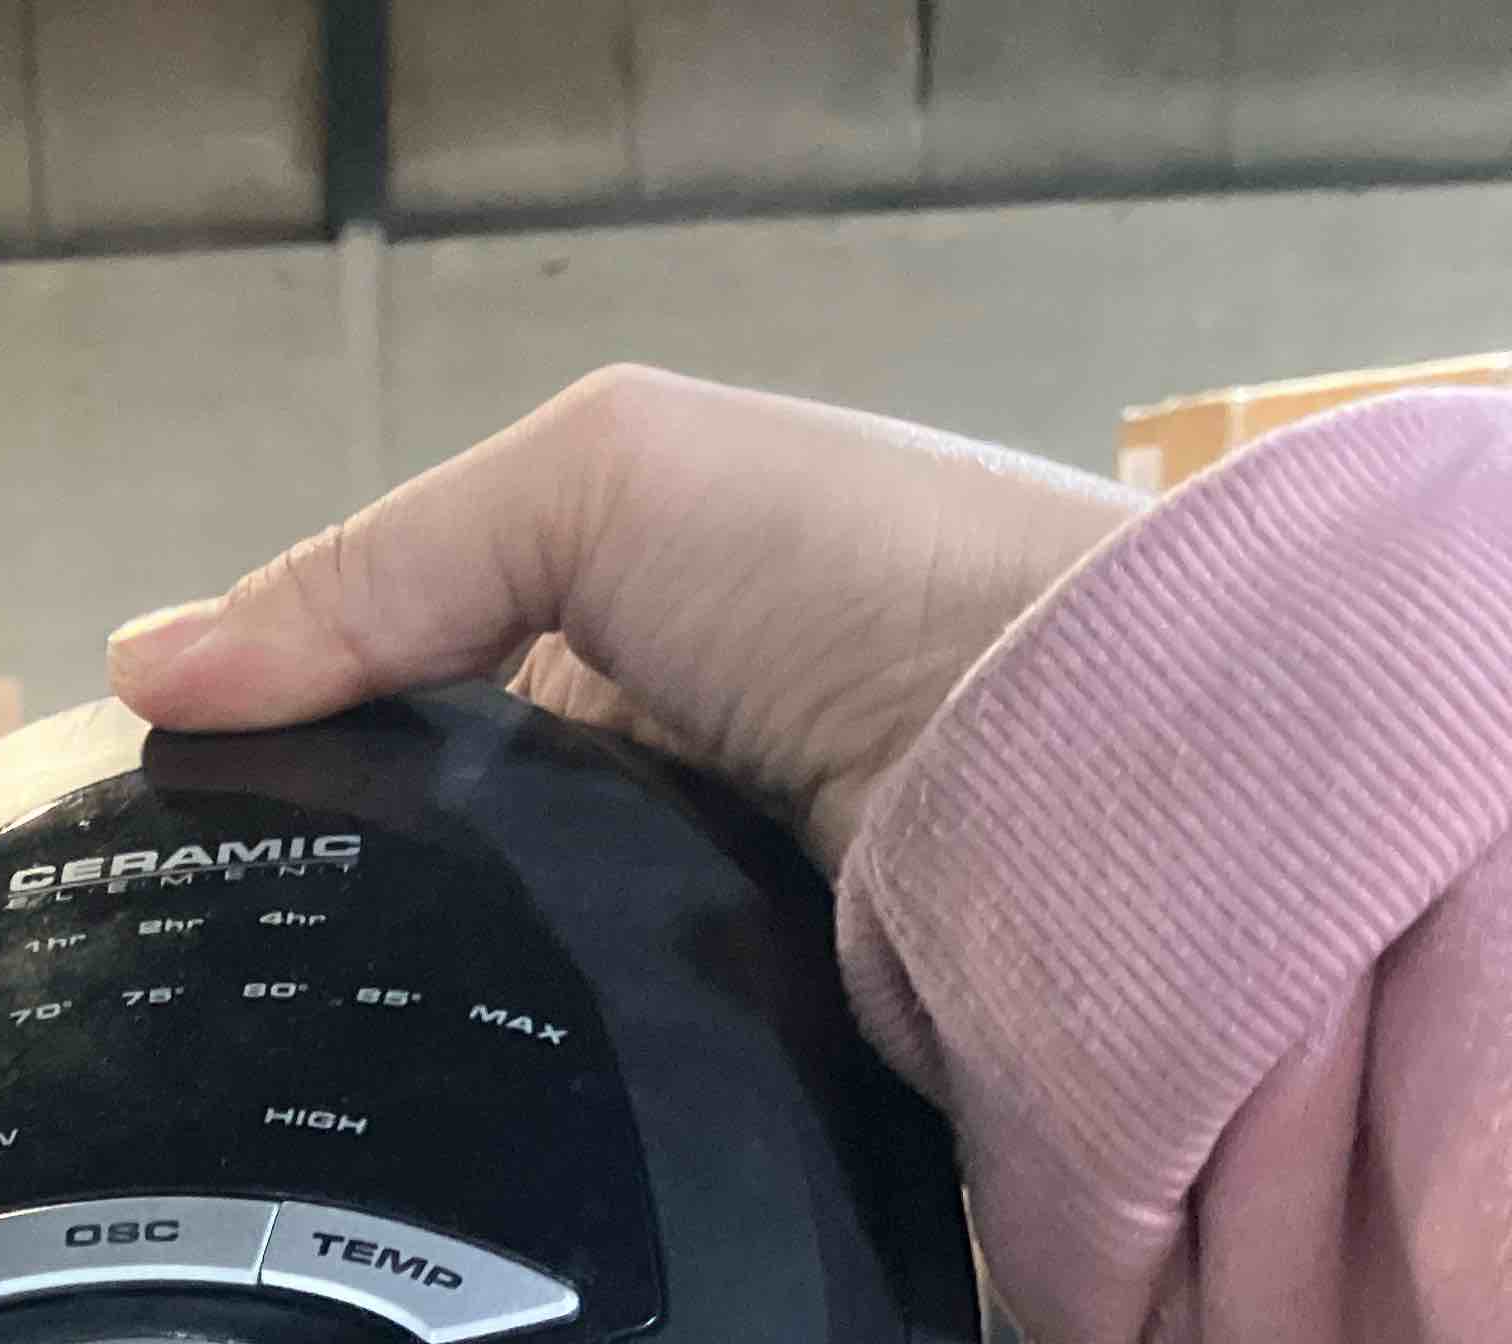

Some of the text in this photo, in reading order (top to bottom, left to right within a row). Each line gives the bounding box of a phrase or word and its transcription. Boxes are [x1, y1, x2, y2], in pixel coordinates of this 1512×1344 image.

[8, 834, 362, 892] CERAMIC
[24, 910, 327, 953] 1hr 2hr 4hr
[468, 1003, 569, 1047] MAX
[263, 1106, 369, 1136] HIGH
[64, 1219, 181, 1249] OSC
[312, 1230, 464, 1293] TEMP
